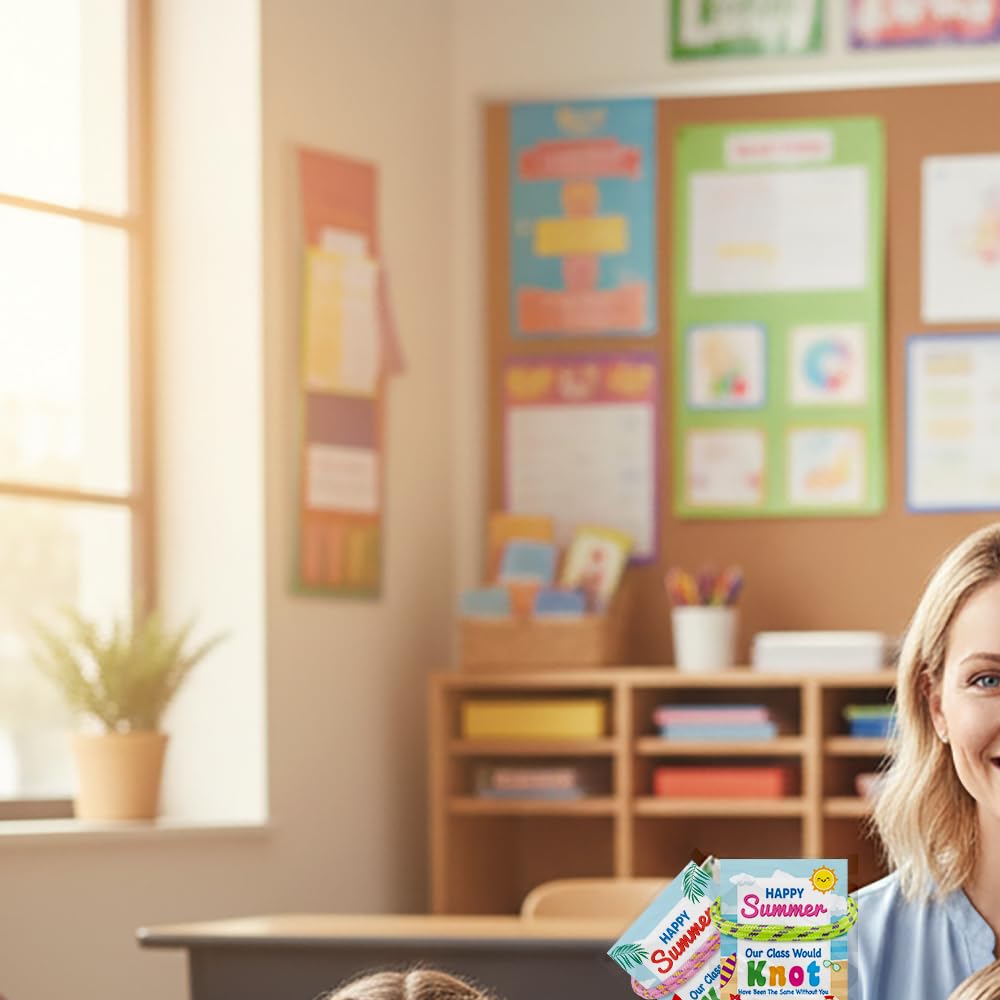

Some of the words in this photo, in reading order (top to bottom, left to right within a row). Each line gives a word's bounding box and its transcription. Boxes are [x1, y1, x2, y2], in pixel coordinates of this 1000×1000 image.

[740, 893, 828, 919] Summer
[765, 887, 804, 899] HAPPY
[650, 906, 712, 974] Summer
[658, 909, 691, 945] HAPPY
[745, 948, 767, 958] Our
[768, 948, 790, 958] Class
[792, 948, 822, 958] Would
[746, 960, 821, 987] Knot
[689, 983, 705, 1000] Our
